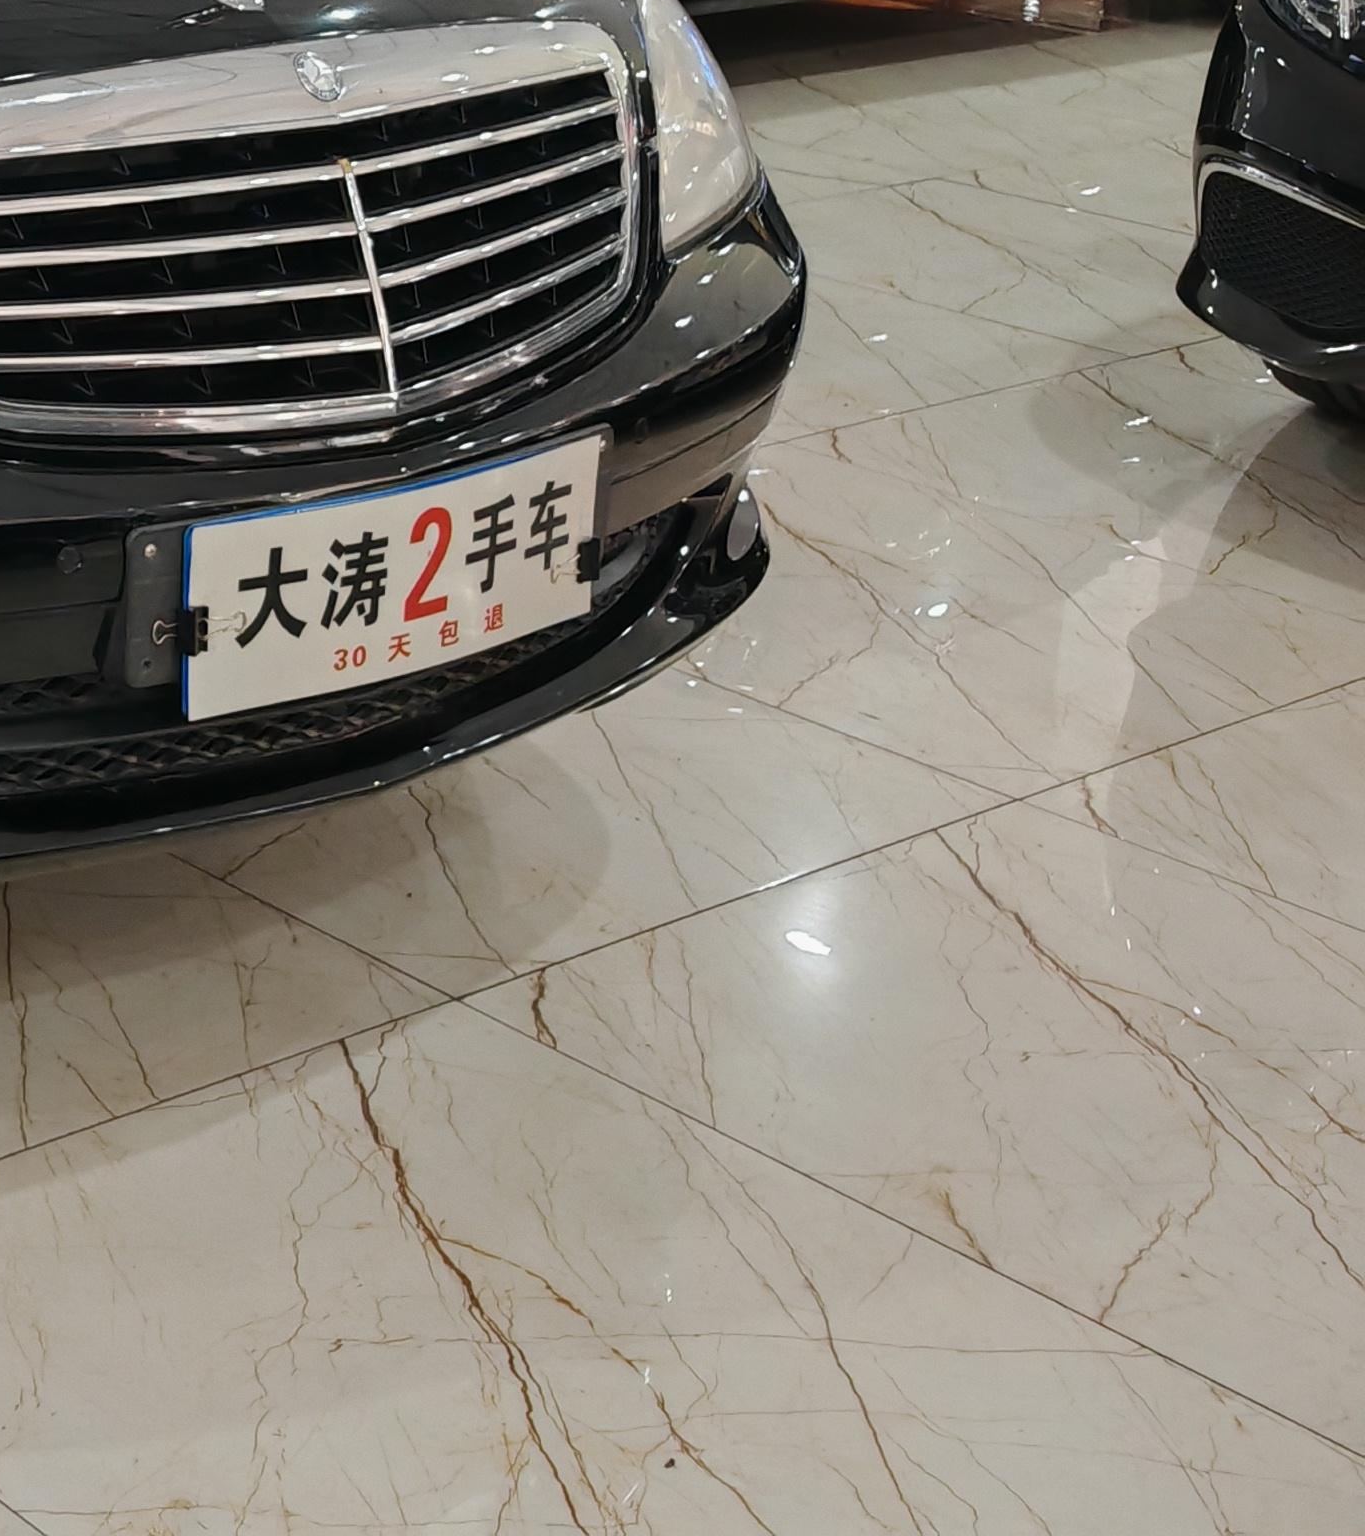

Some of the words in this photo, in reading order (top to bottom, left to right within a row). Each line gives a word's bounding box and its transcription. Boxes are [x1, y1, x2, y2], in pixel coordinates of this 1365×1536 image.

[234, 479, 573, 649] 大涛2手车
[333, 604, 504, 672] 30天包退
